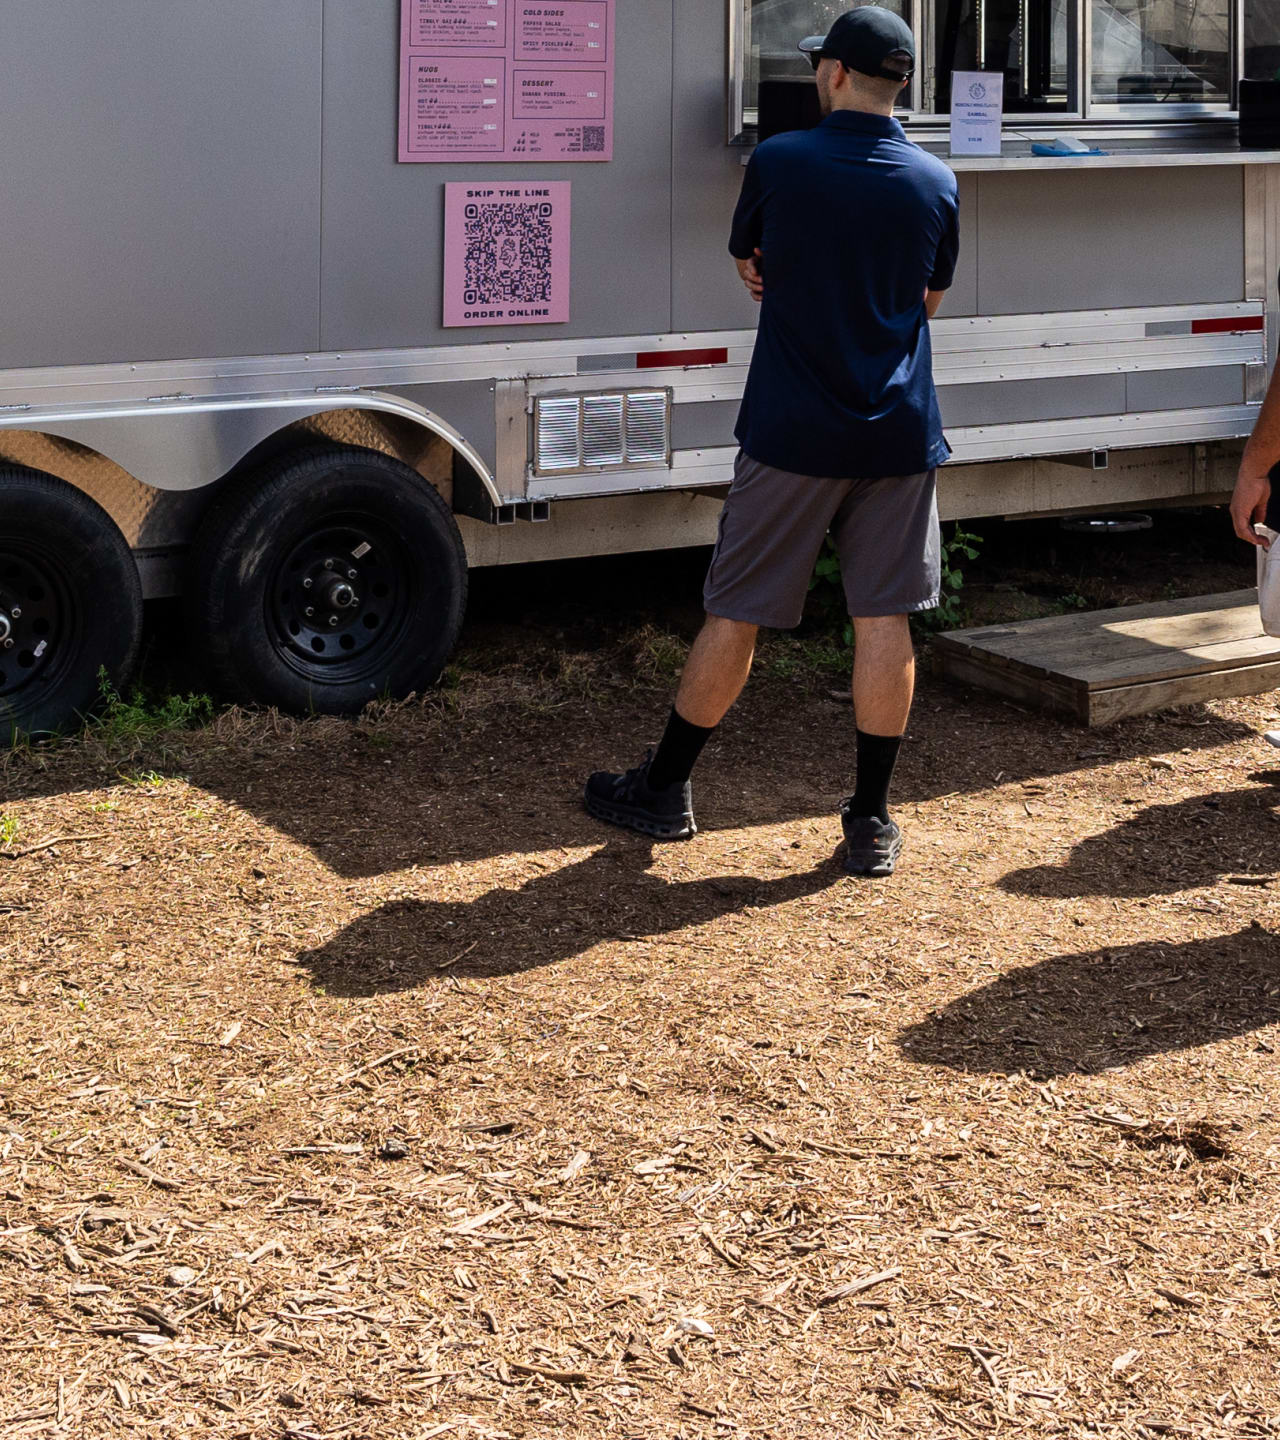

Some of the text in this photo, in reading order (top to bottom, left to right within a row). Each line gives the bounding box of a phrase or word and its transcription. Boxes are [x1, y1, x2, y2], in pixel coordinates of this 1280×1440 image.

[522, 79, 554, 87] DESSERT
[499, 189, 521, 197] THE
[464, 308, 549, 319] ORDER ONLINE
